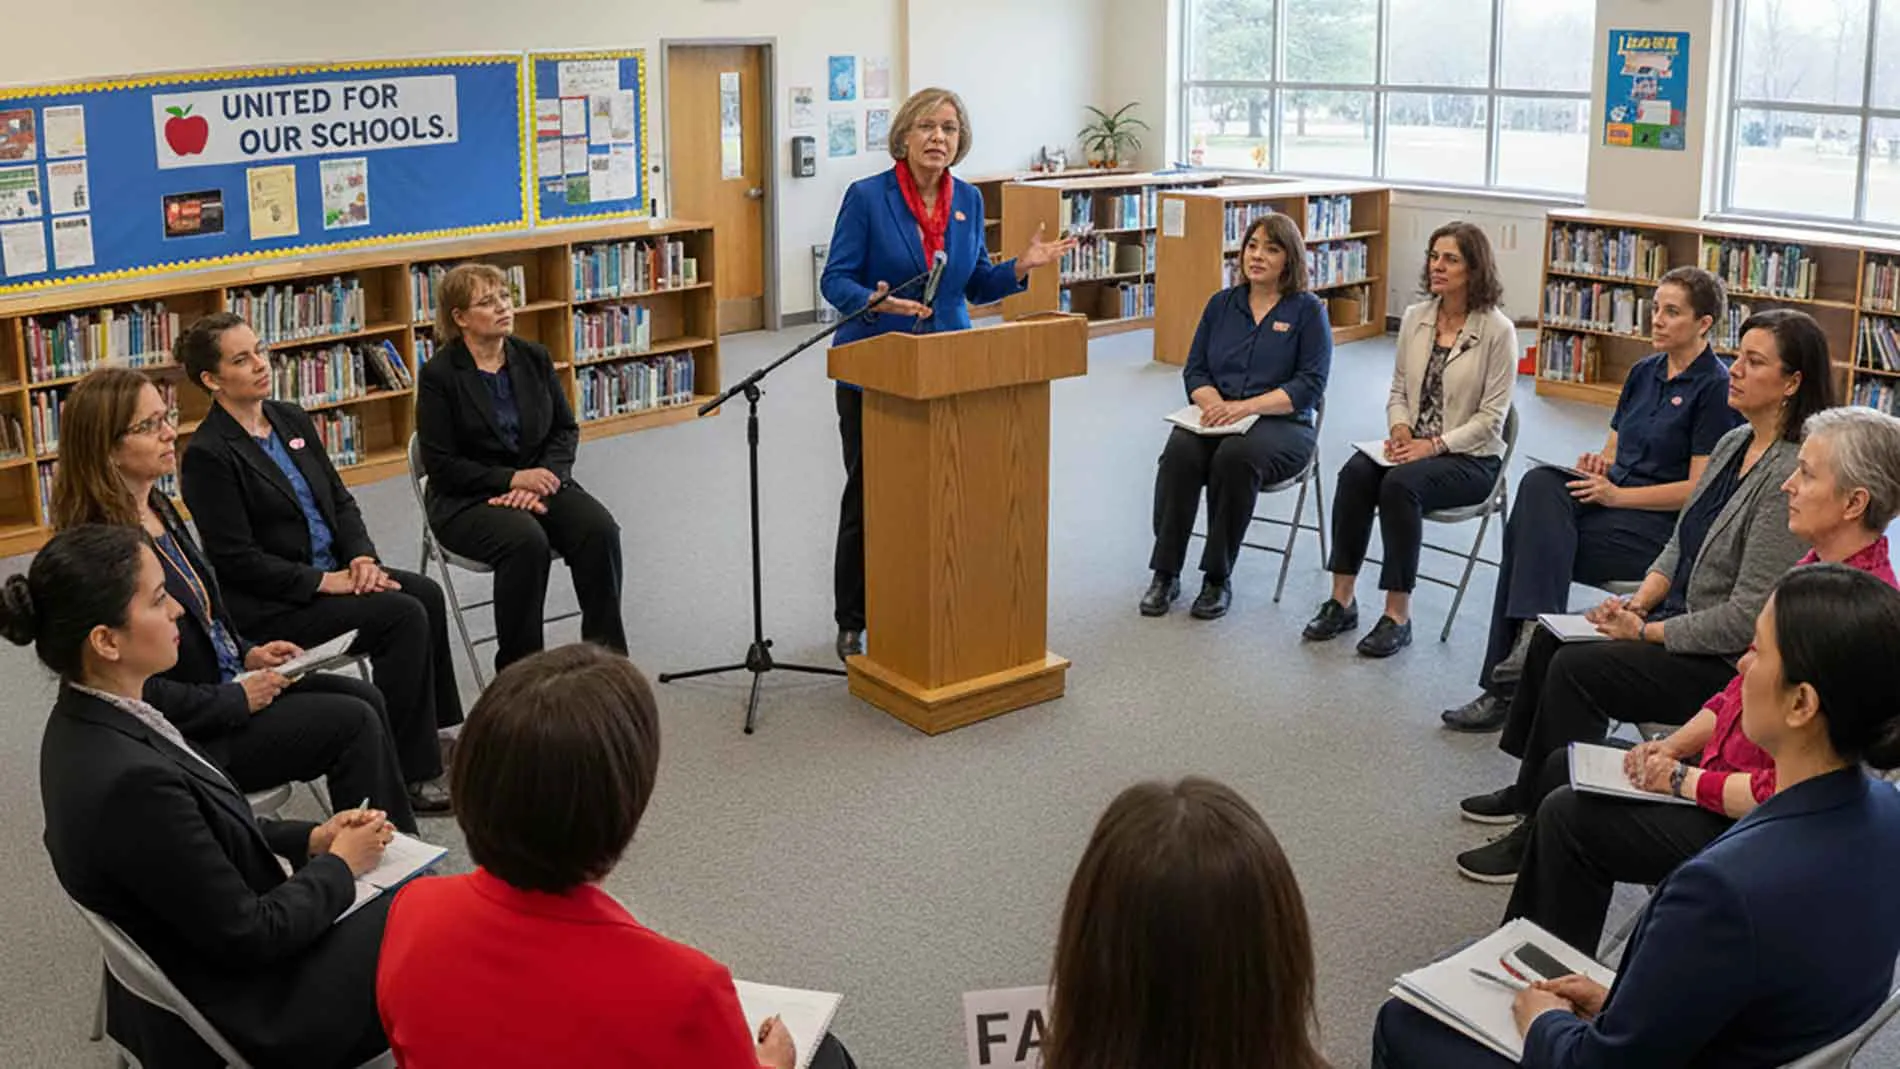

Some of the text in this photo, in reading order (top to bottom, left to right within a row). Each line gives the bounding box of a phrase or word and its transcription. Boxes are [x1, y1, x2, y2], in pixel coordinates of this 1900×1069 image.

[222, 85, 398, 120] UNITED FOR
[239, 114, 454, 155] OUR SCHOOLS.
